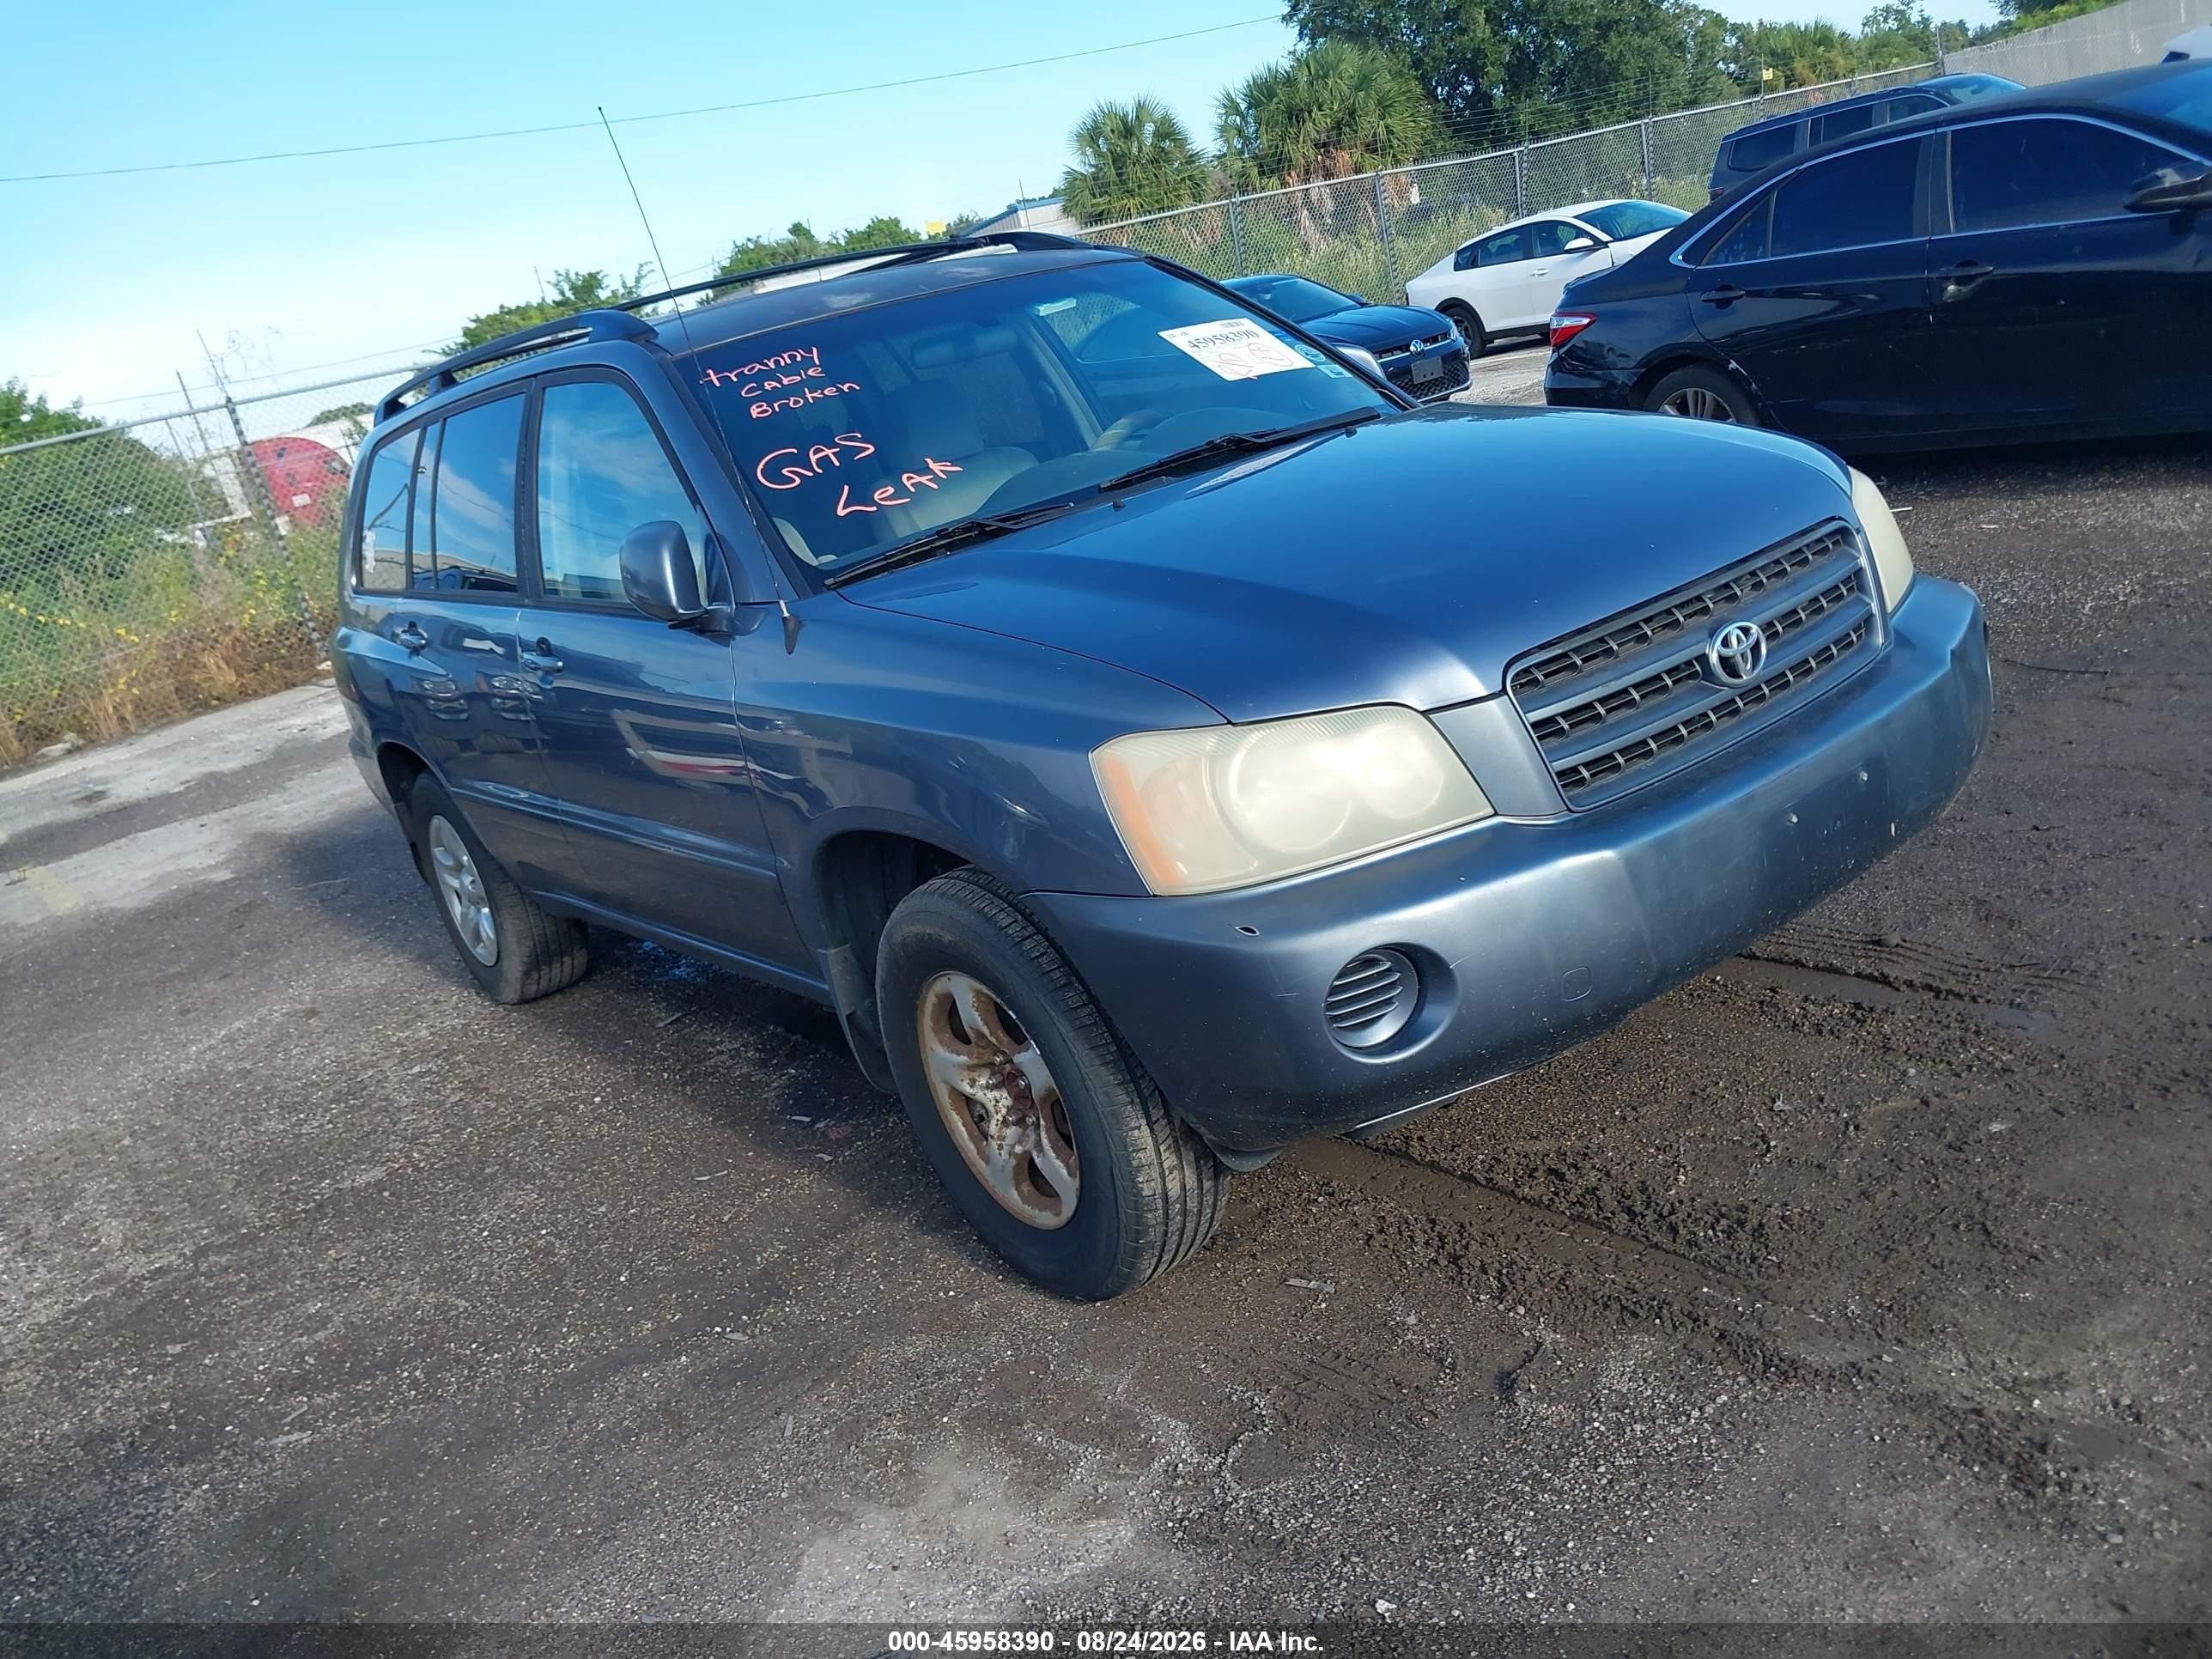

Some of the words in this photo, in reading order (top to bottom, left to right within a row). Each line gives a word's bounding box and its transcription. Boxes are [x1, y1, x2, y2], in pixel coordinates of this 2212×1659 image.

[1187, 329, 1261, 349] 45958390
[699, 346, 821, 387] tranny
[749, 381, 860, 419] Broken
[757, 433, 876, 489] GAS
